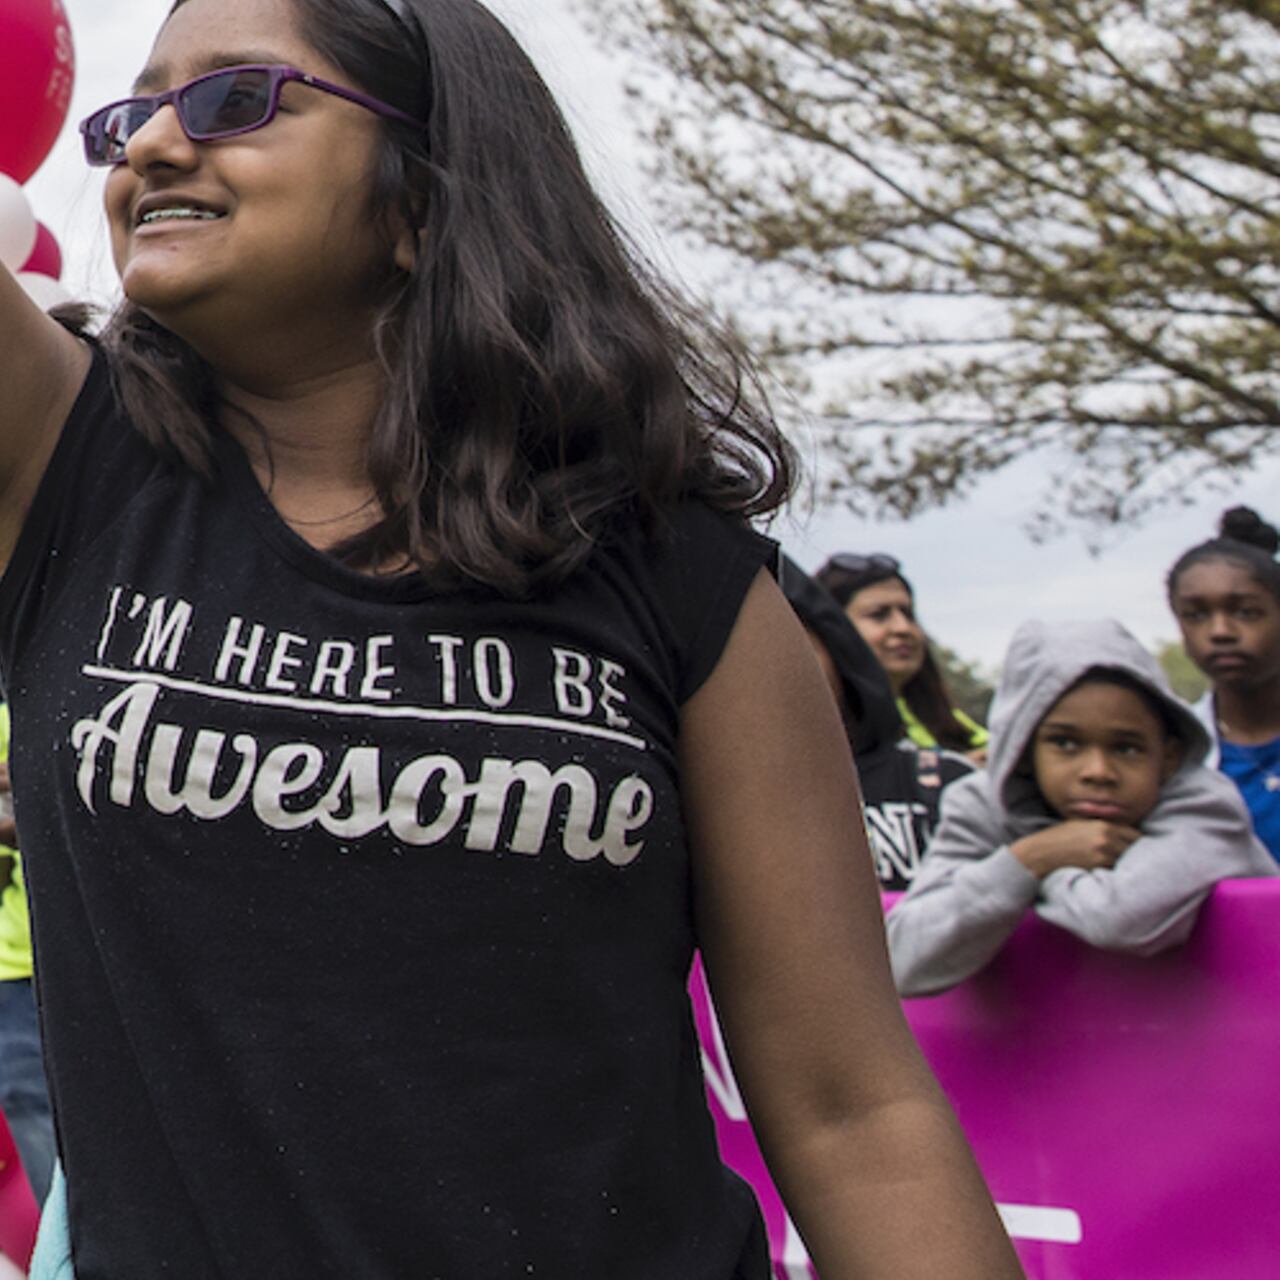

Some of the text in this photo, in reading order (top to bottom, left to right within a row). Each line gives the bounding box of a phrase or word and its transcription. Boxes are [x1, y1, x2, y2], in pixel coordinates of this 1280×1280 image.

[97, 586, 631, 729] I'M HERE TO BE
[71, 682, 652, 866] Awesome
